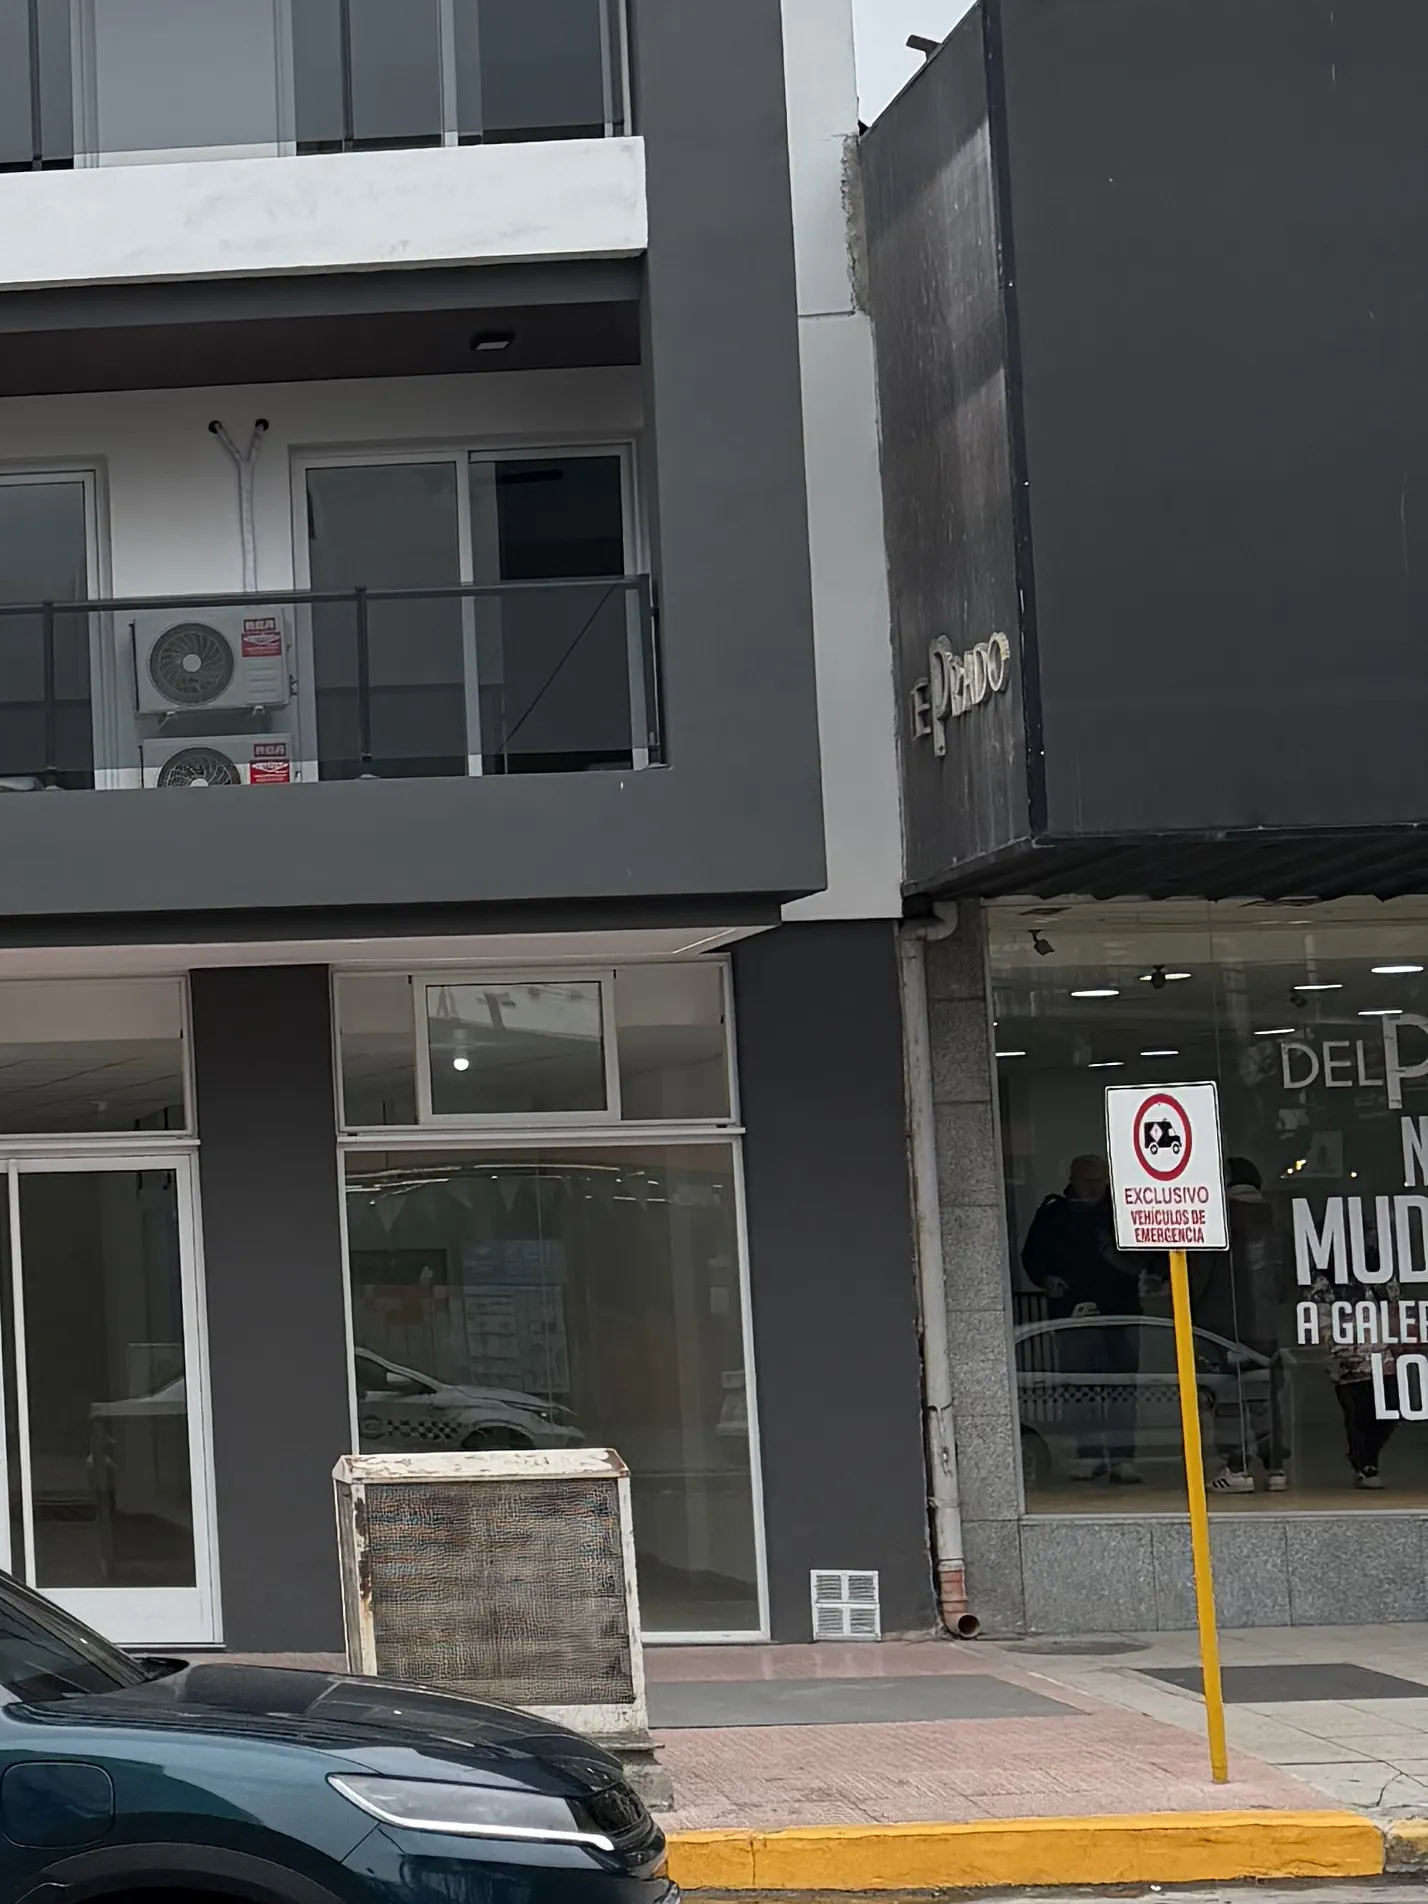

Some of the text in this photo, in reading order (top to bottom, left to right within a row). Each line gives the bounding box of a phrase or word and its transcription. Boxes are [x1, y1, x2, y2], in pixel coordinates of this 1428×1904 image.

[1280, 1040, 1384, 1090] DEL
[1124, 1186, 1210, 1205] EXCLUSIVO
[1130, 1207, 1206, 1225] VEHÍCULOS DE
[1134, 1227, 1205, 1243] EMERGENCIA
[1291, 1195, 1428, 1286] MUD
[1296, 1300, 1320, 1345] A
[1370, 1352, 1428, 1421] LO
